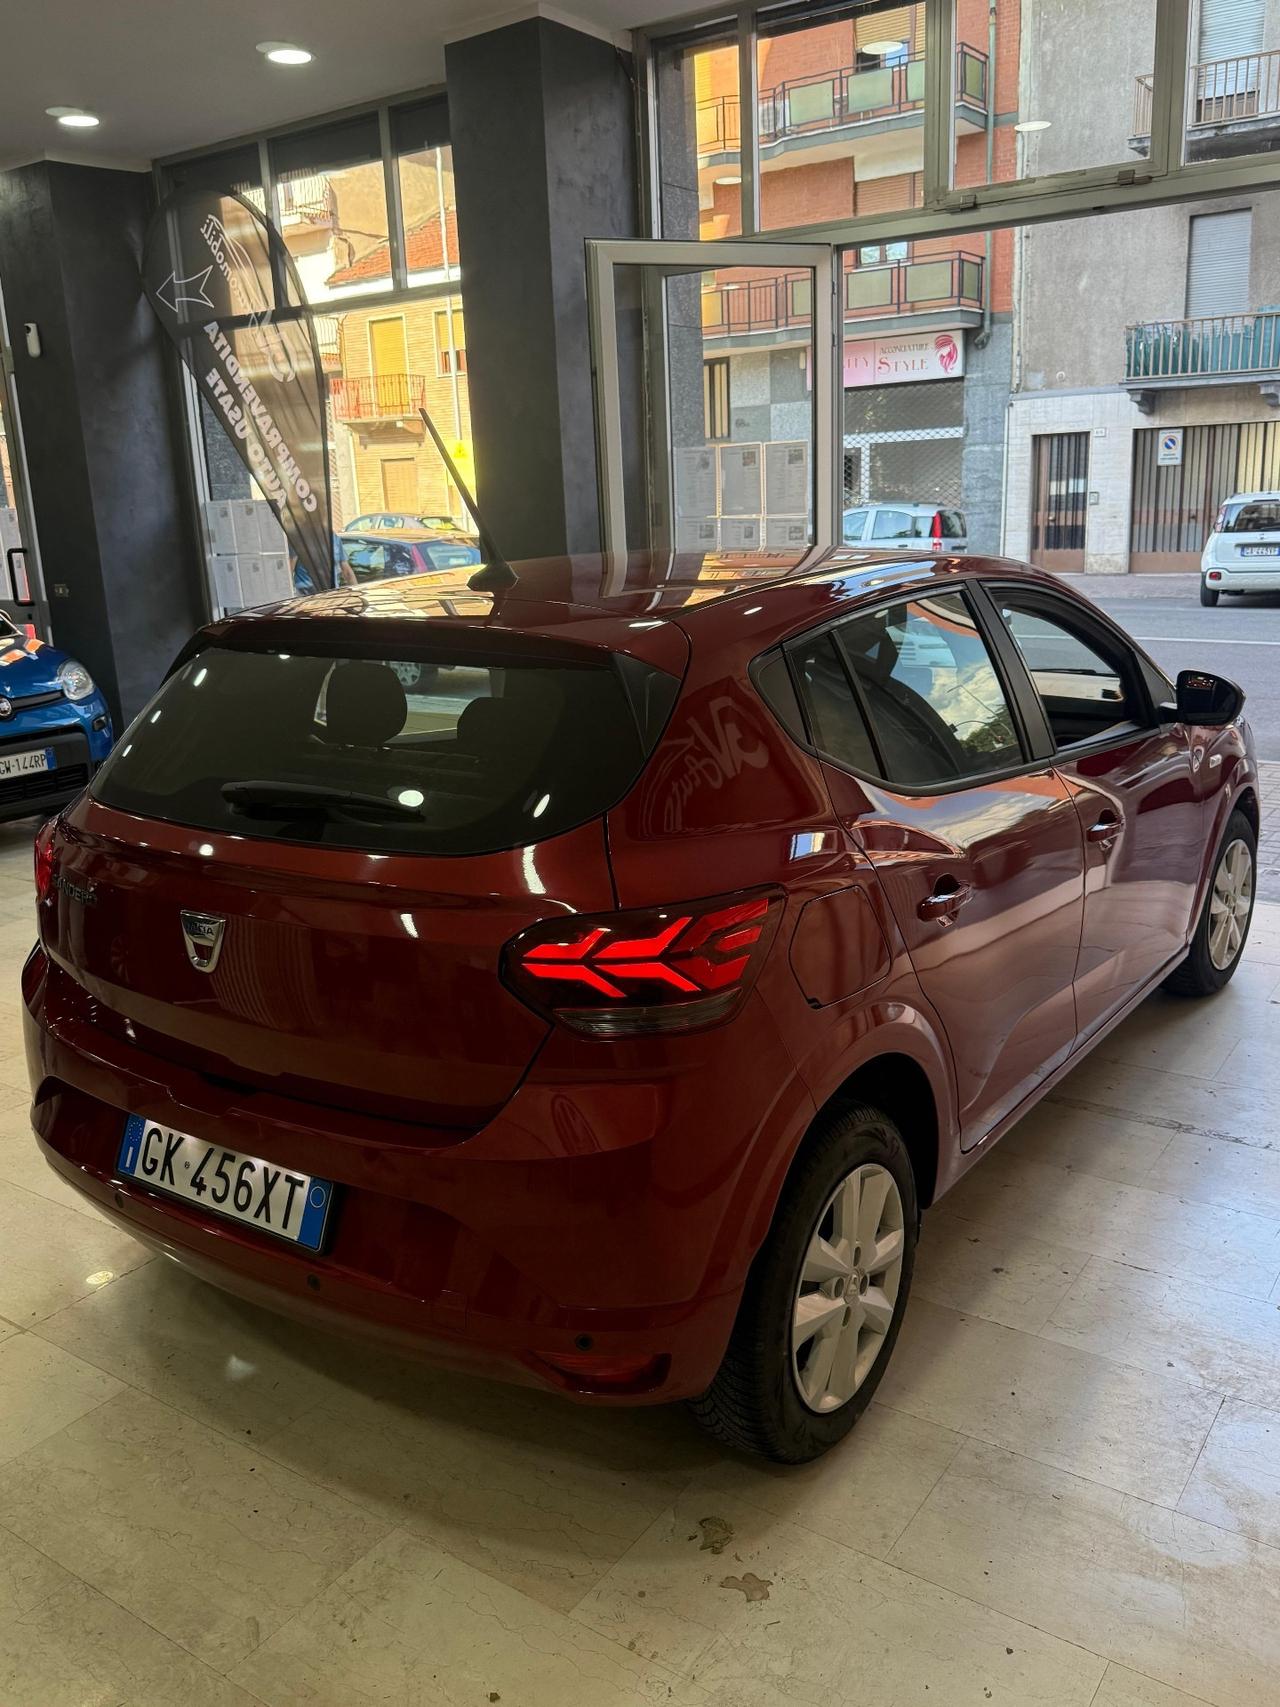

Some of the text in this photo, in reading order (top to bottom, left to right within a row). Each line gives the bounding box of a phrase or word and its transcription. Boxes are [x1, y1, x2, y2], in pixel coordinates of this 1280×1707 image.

[877, 356, 929, 375] STYLE
[141, 1127, 184, 1186] GK
[190, 1147, 305, 1230] 456XT
